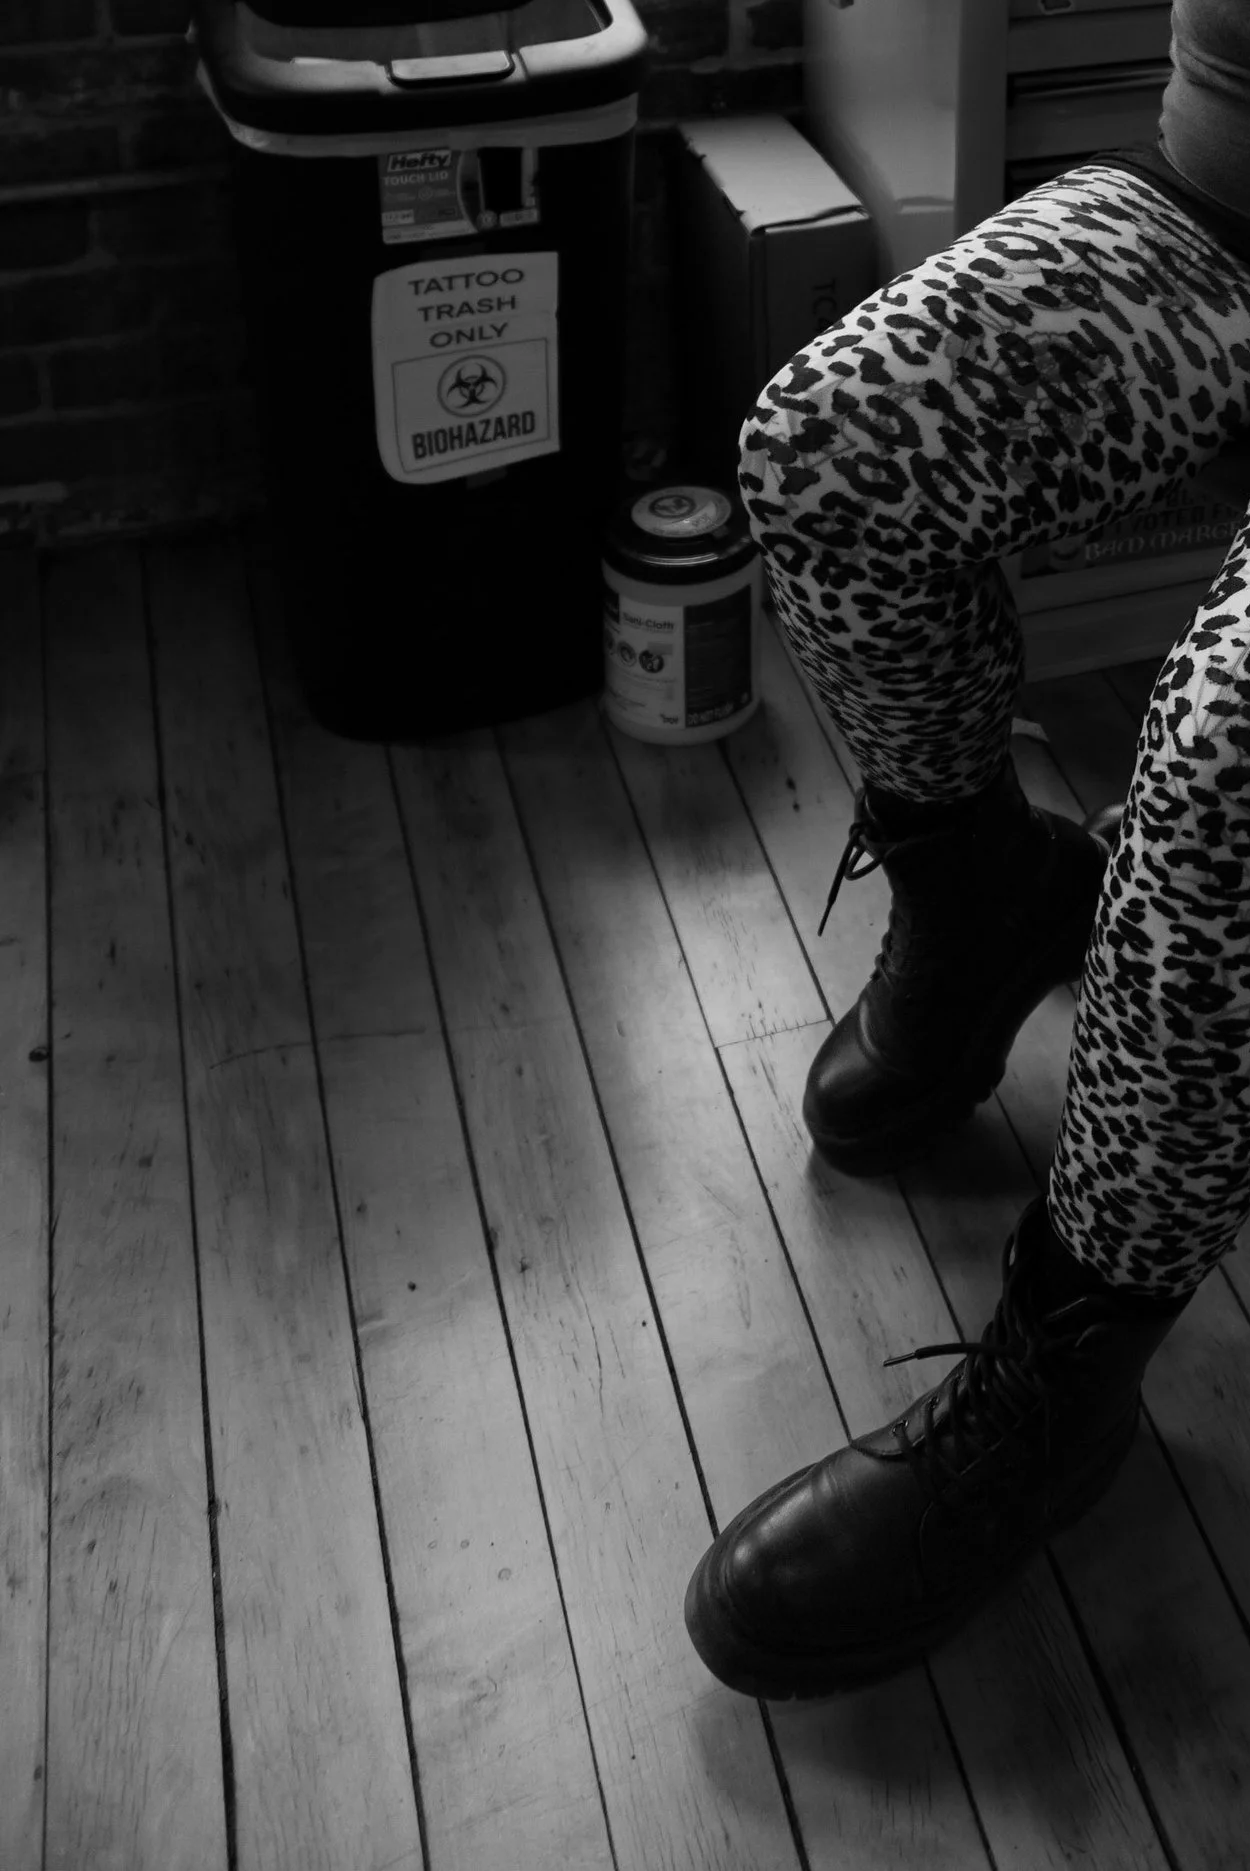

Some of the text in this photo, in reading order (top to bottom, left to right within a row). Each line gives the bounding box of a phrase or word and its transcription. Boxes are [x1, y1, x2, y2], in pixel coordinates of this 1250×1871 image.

[390, 151, 450, 169] Hefty
[383, 170, 449, 187] TOUCH LID
[409, 266, 525, 296] TATTOO
[418, 294, 517, 323] TRASH
[429, 322, 509, 349] ONLY
[411, 409, 536, 461] BIOHAZARD
[1132, 506, 1206, 532] VOTED
